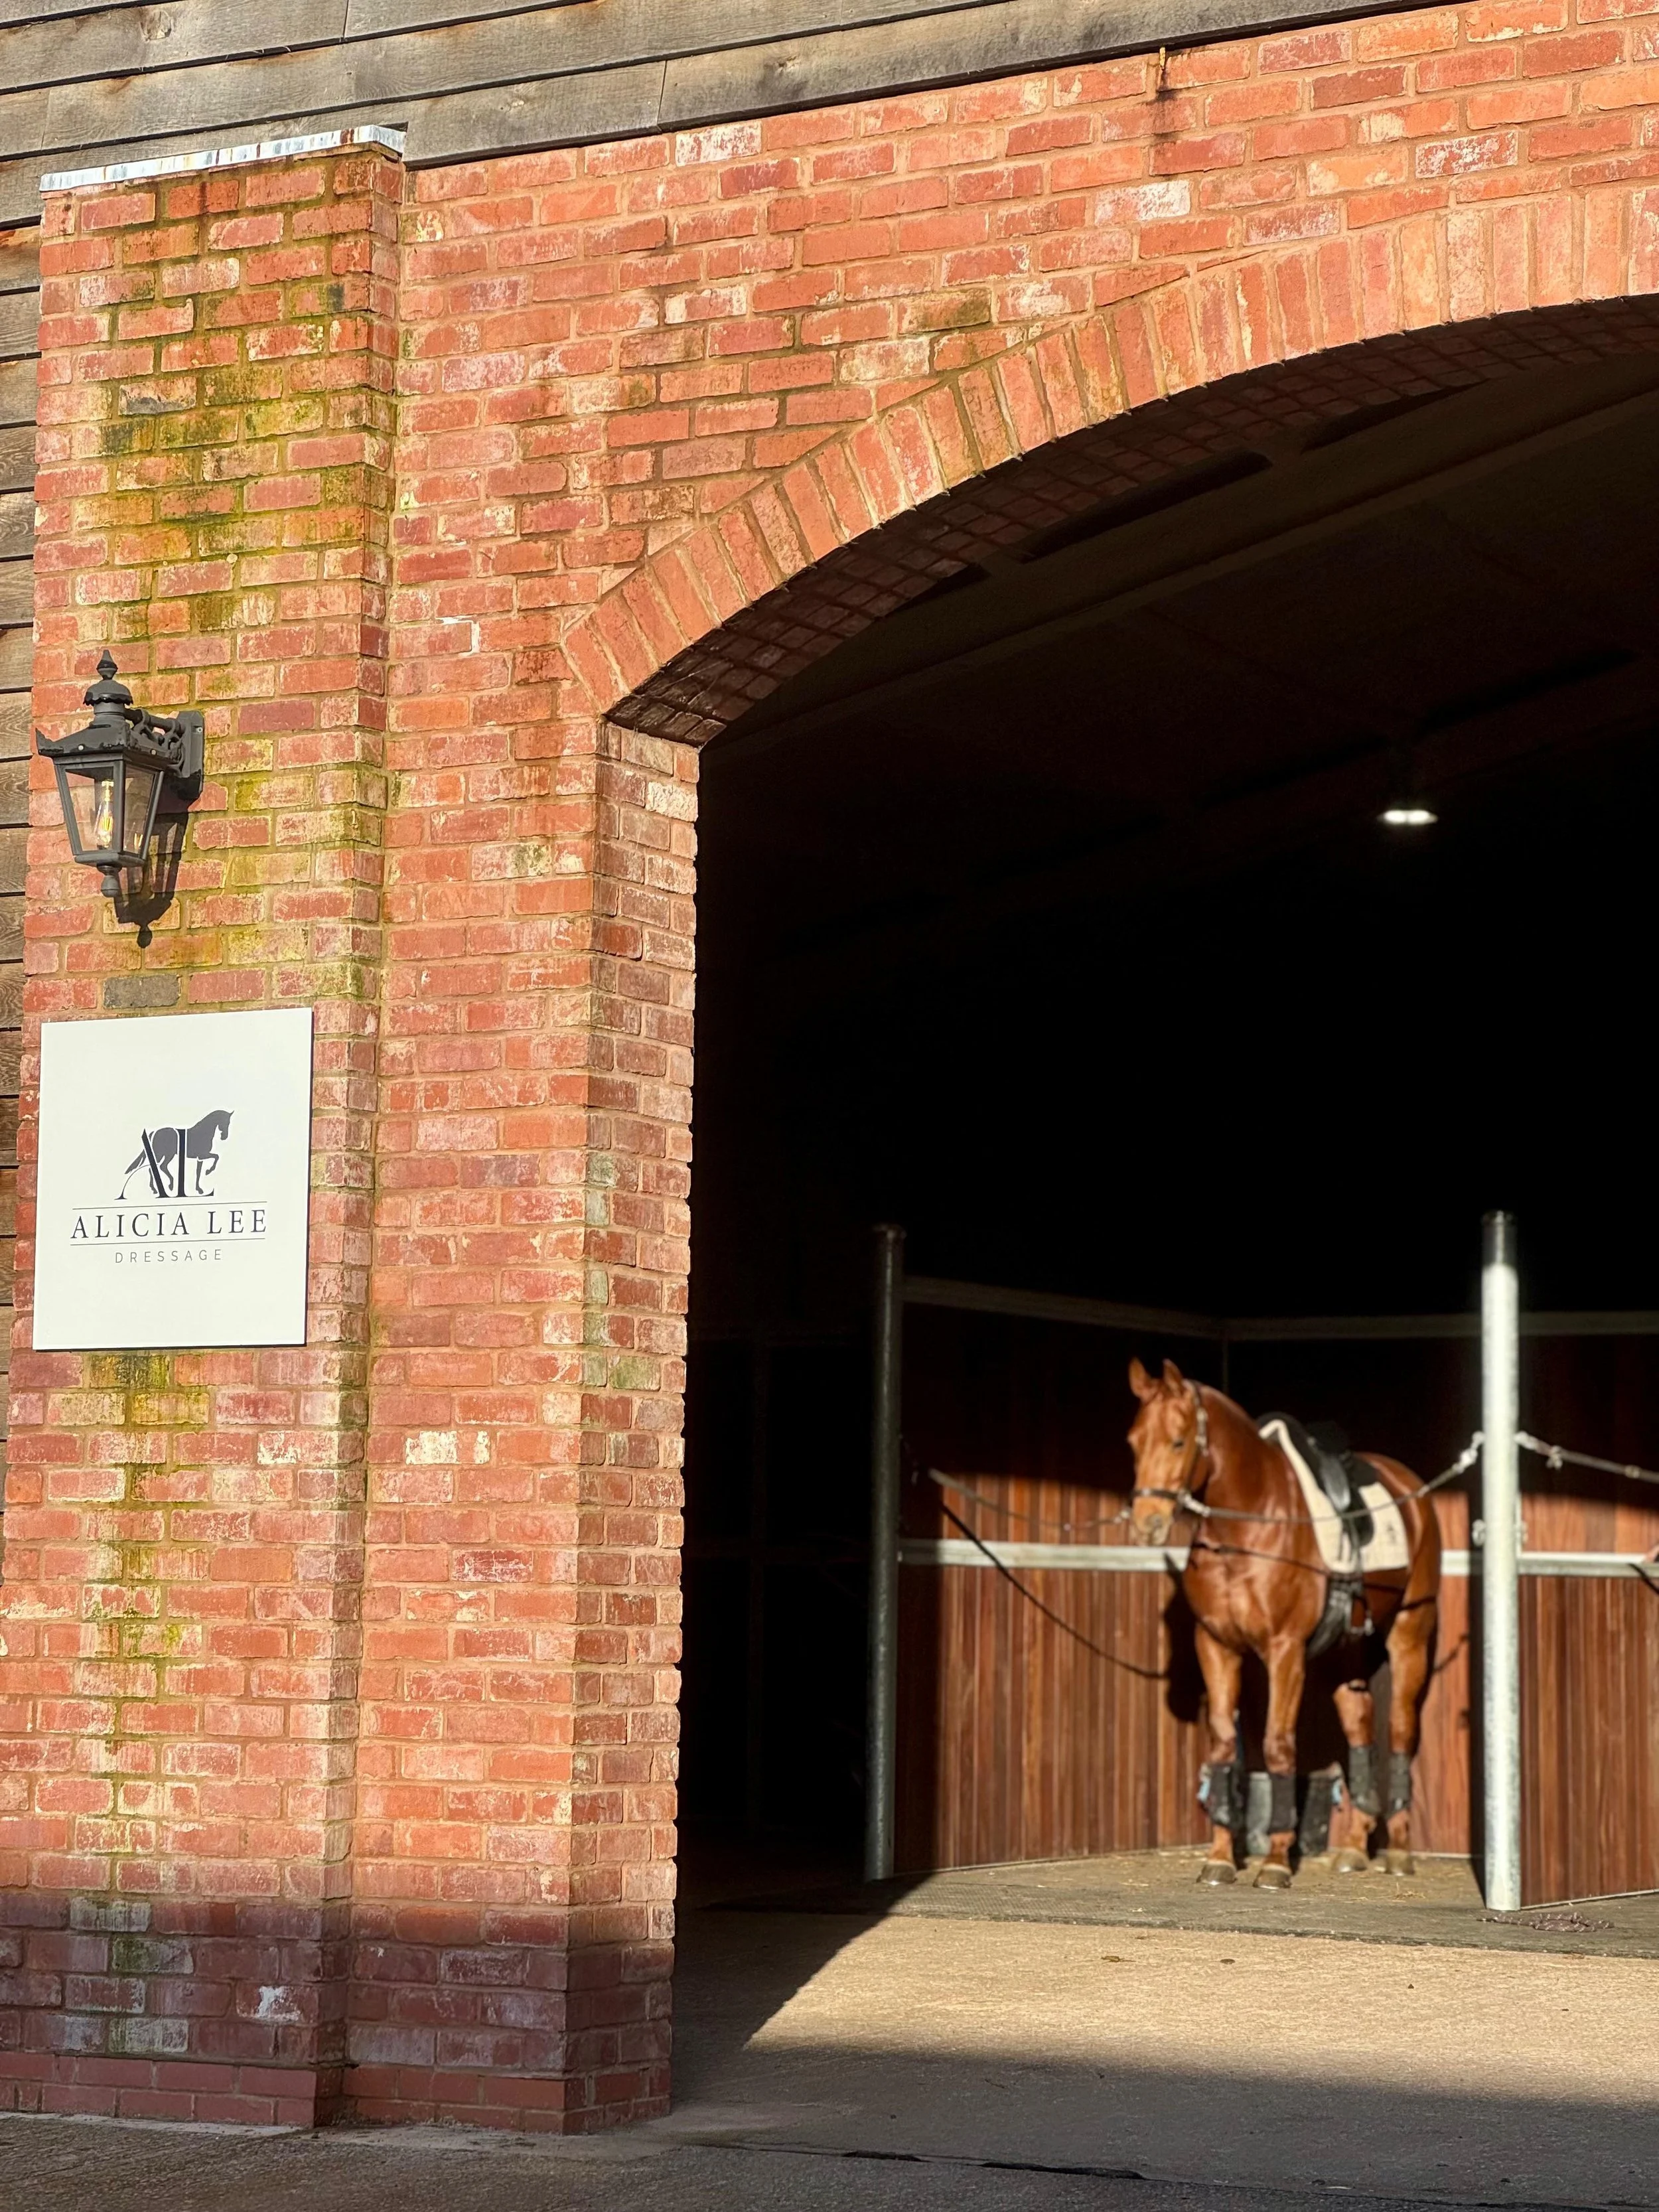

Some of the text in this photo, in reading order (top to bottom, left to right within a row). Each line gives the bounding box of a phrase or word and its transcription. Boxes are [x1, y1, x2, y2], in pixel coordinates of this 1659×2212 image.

[70, 1209, 266, 1239] ALICIA LEE
[115, 1249, 221, 1264] DRESSAGE
